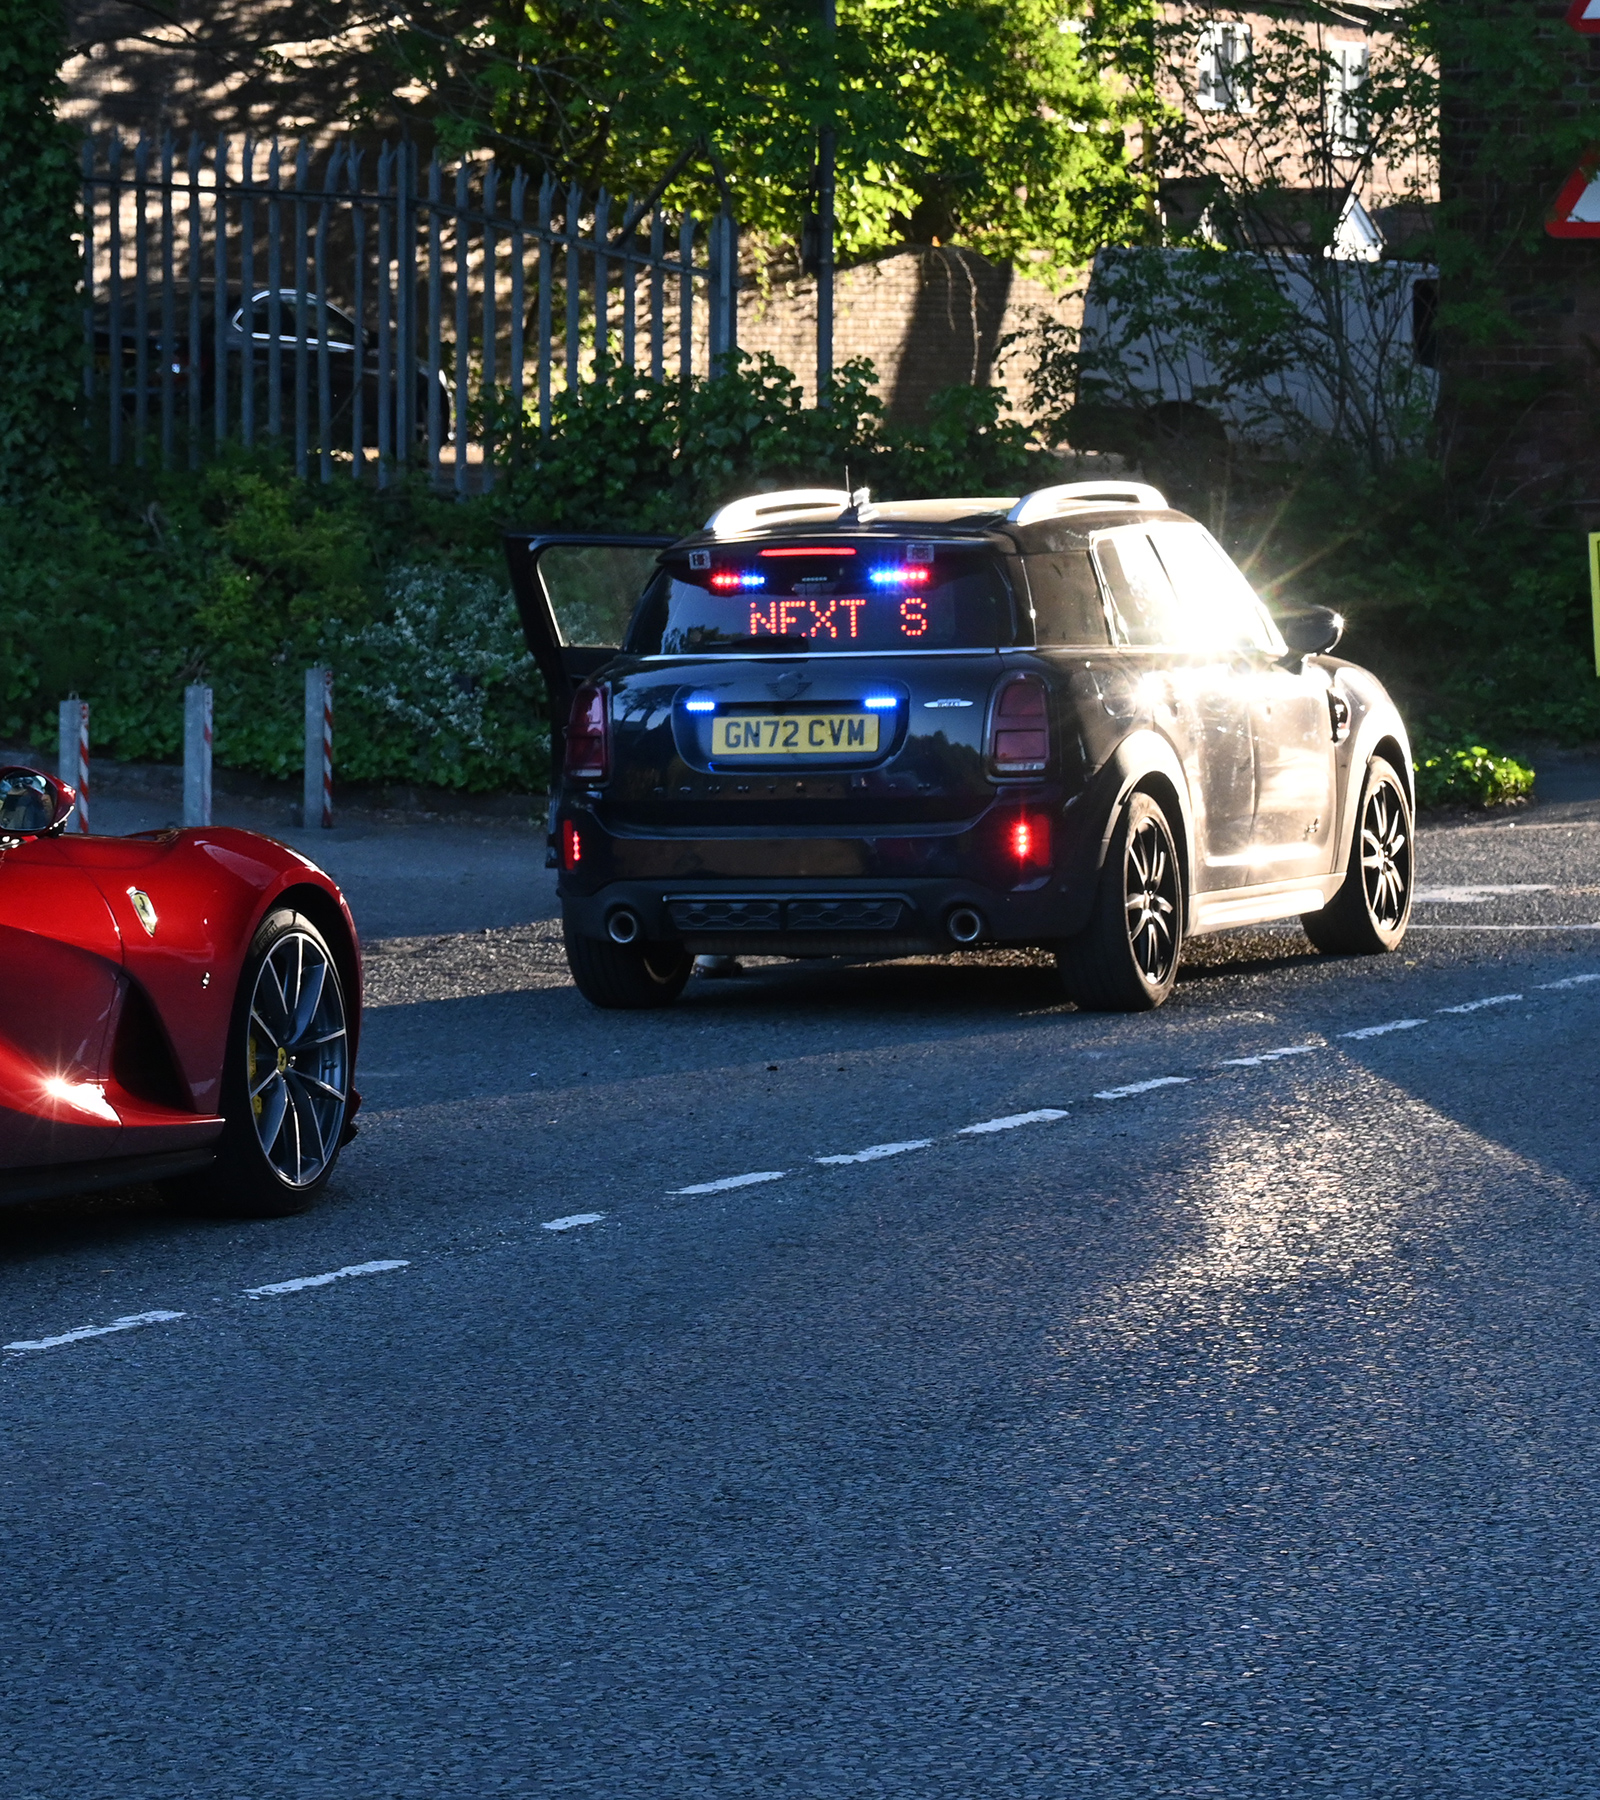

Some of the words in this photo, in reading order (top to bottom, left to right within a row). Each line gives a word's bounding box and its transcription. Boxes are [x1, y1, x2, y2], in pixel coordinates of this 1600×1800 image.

[750, 599, 866, 638] NEXT
[900, 597, 928, 636] S
[725, 720, 799, 748] GN72
[808, 719, 865, 747] CVM
